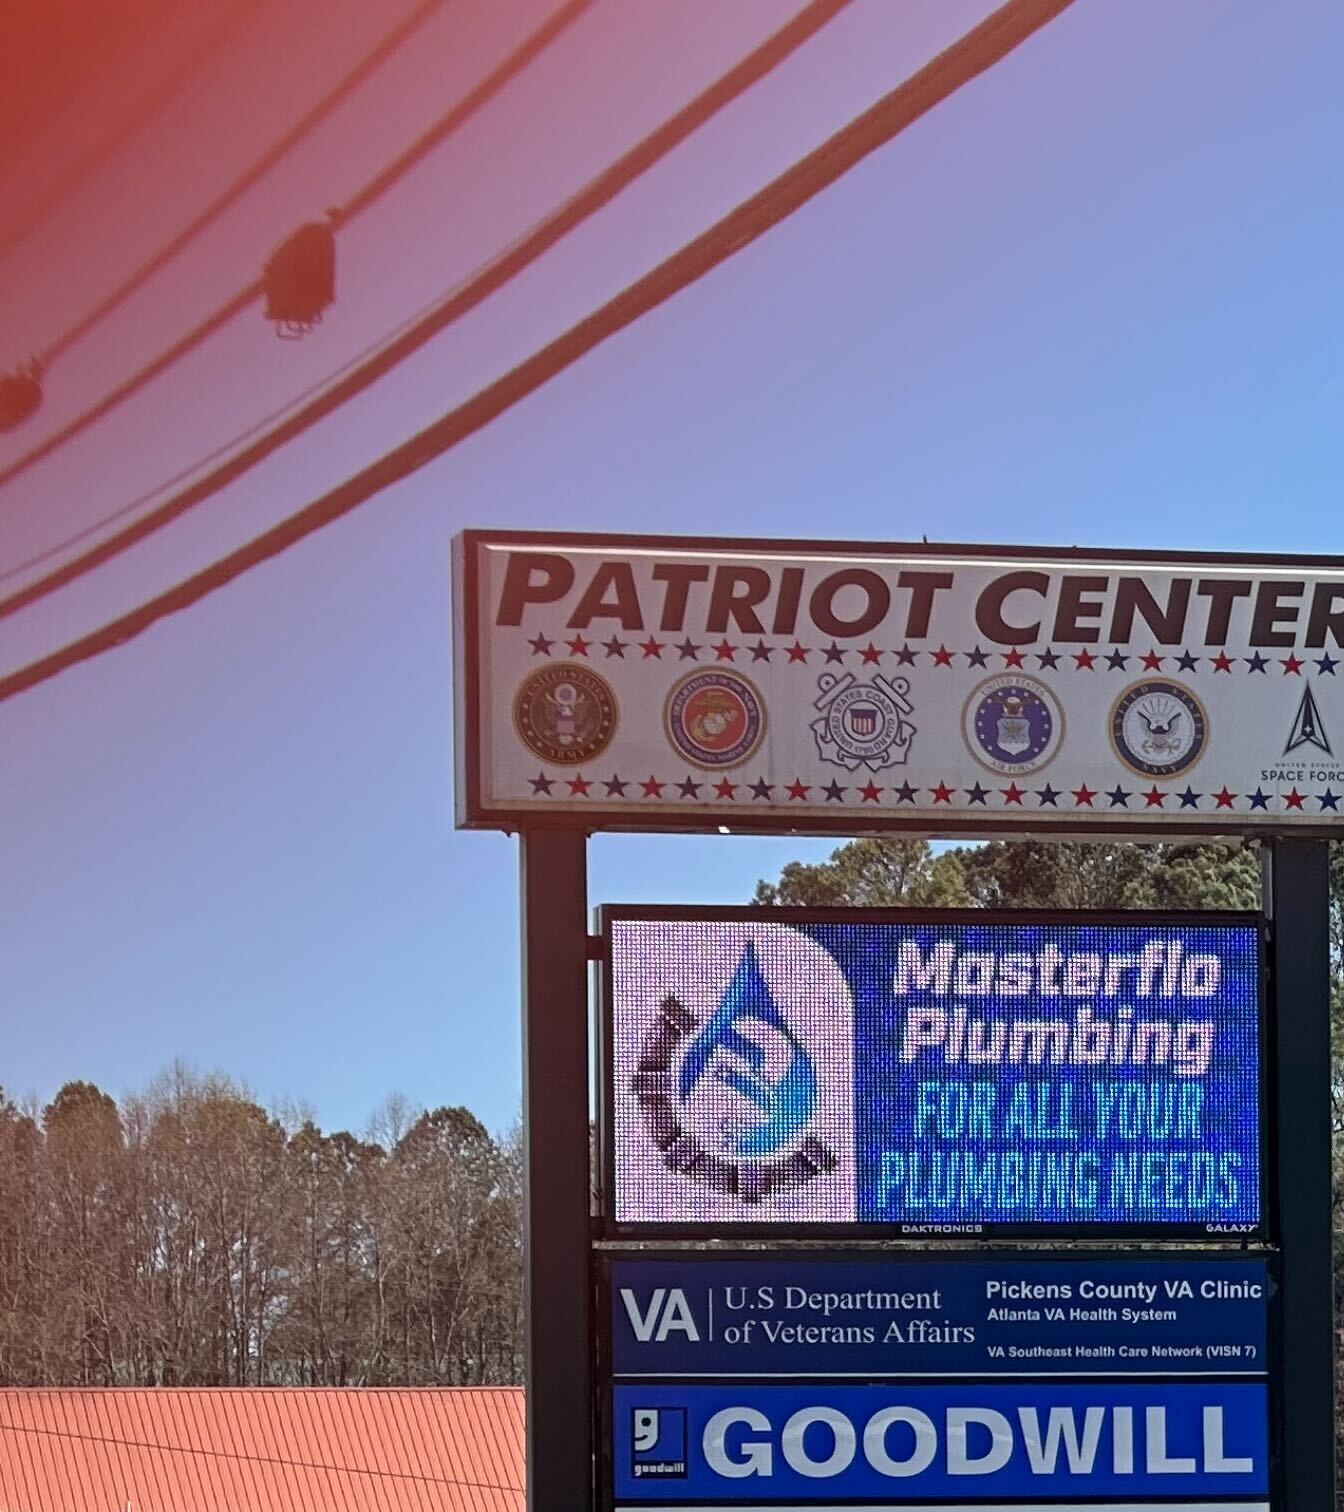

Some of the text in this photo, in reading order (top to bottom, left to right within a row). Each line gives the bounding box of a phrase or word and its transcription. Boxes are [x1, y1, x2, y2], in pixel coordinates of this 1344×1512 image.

[496, 551, 955, 638] PATRIOT
[834, 690, 862, 713] STATES
[865, 690, 894, 715] COAST
[1261, 770, 1304, 782] SPACE
[893, 938, 1222, 998] Masterflo
[898, 1004, 1214, 1076] Plumbing
[913, 1082, 1204, 1139] FOR ALL YOUR
[877, 1151, 1243, 1208] PLUMBING NEEDS
[901, 1224, 983, 1234] DAKTRONICS
[724, 1286, 942, 1316] U.S Department
[986, 1280, 1262, 1303] Pickens County VA Clinic
[620, 1287, 701, 1343] VA
[987, 1308, 1177, 1324] Atlanta VA Health System
[724, 1319, 976, 1344] of Veterans Affairs
[987, 1345, 1257, 1359] VA Southeast Health Care Network (VISN 7)
[702, 1405, 1254, 1478] GOODWILL
[634, 1462, 684, 1477] goodwill
